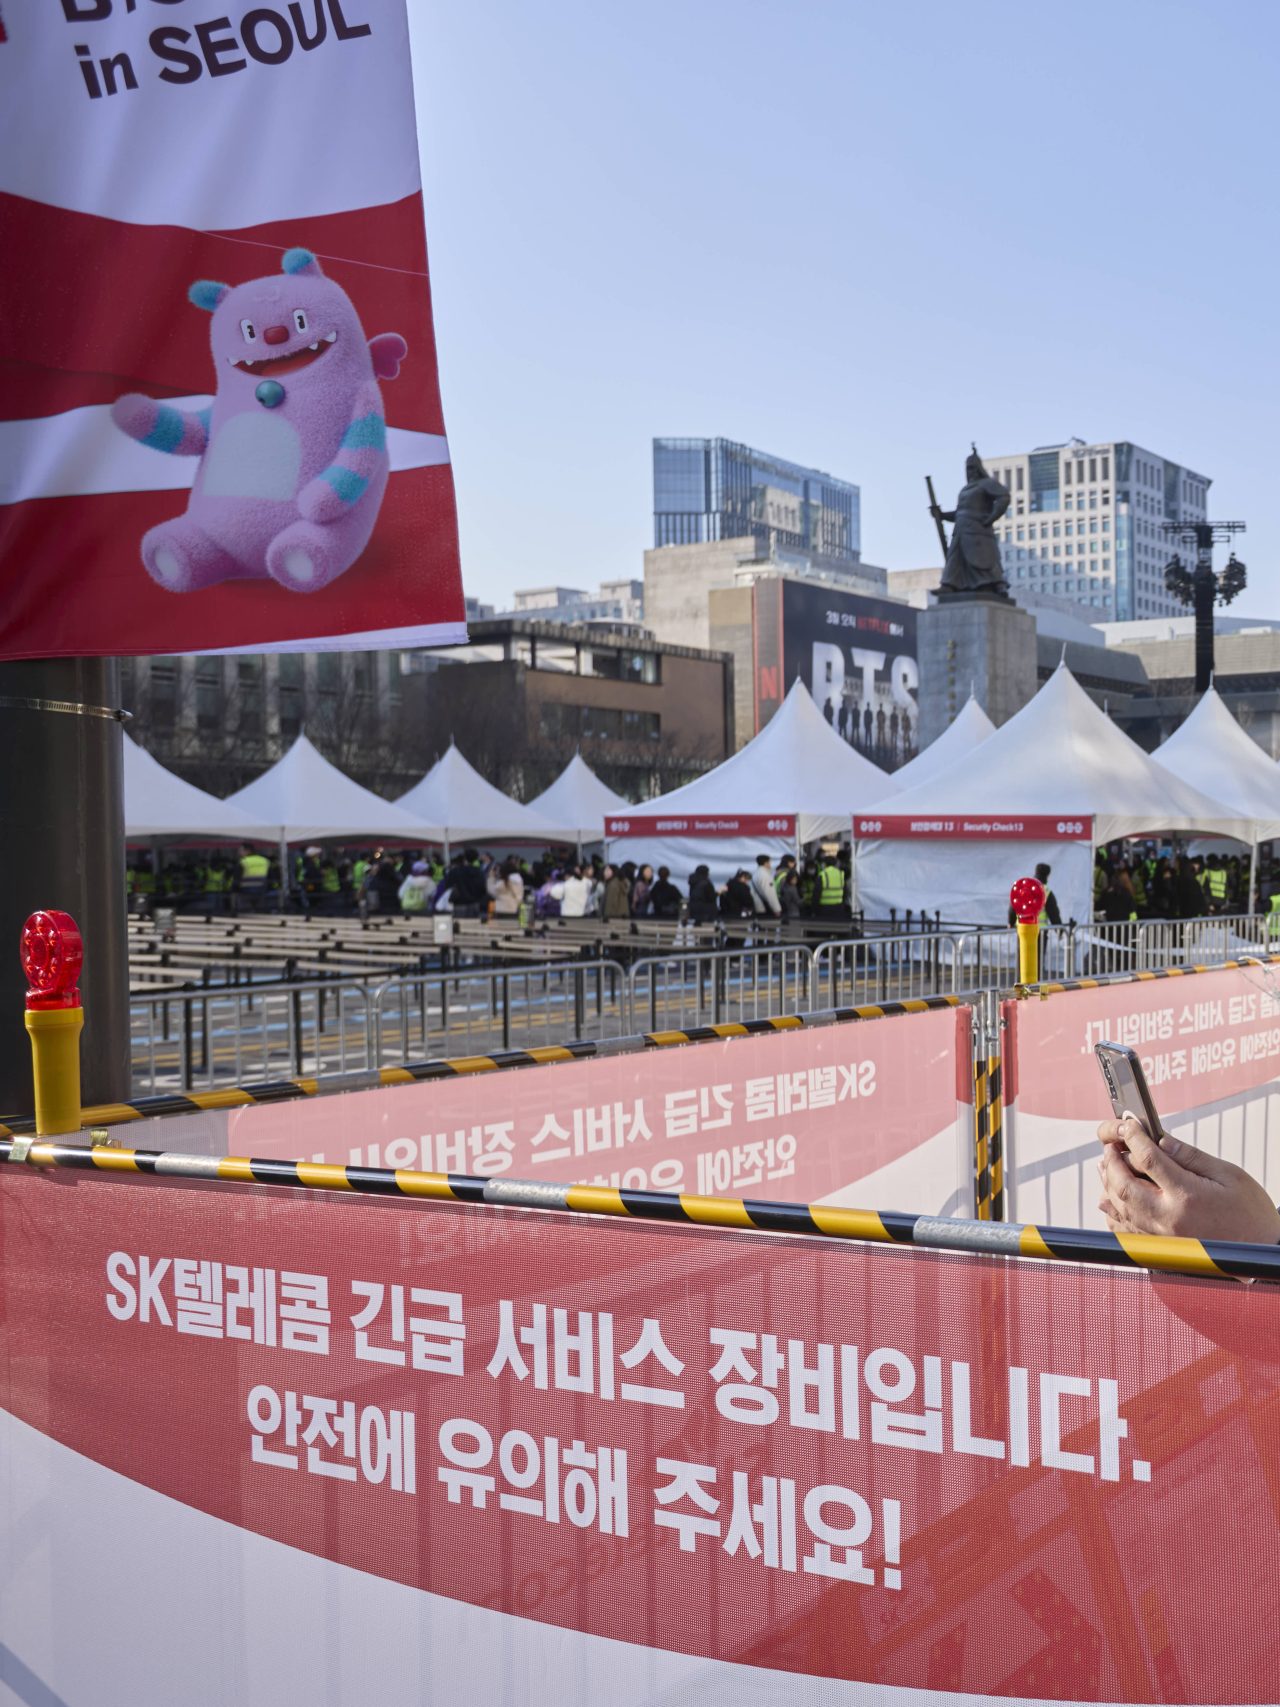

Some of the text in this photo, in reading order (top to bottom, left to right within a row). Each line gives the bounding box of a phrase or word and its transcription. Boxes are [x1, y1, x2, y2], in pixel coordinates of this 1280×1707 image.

[74, 0, 372, 99] in SEOUL
[760, 666, 777, 699] N
[812, 641, 919, 745] BTS
[963, 822, 991, 832] Security
[106, 1250, 1152, 1483] SK텔레콤 긴급 서비스 장비입니다.
[247, 1385, 417, 1495] 안전에
[437, 1418, 630, 1539] 유의해
[653, 1457, 903, 1592] 주세요!
